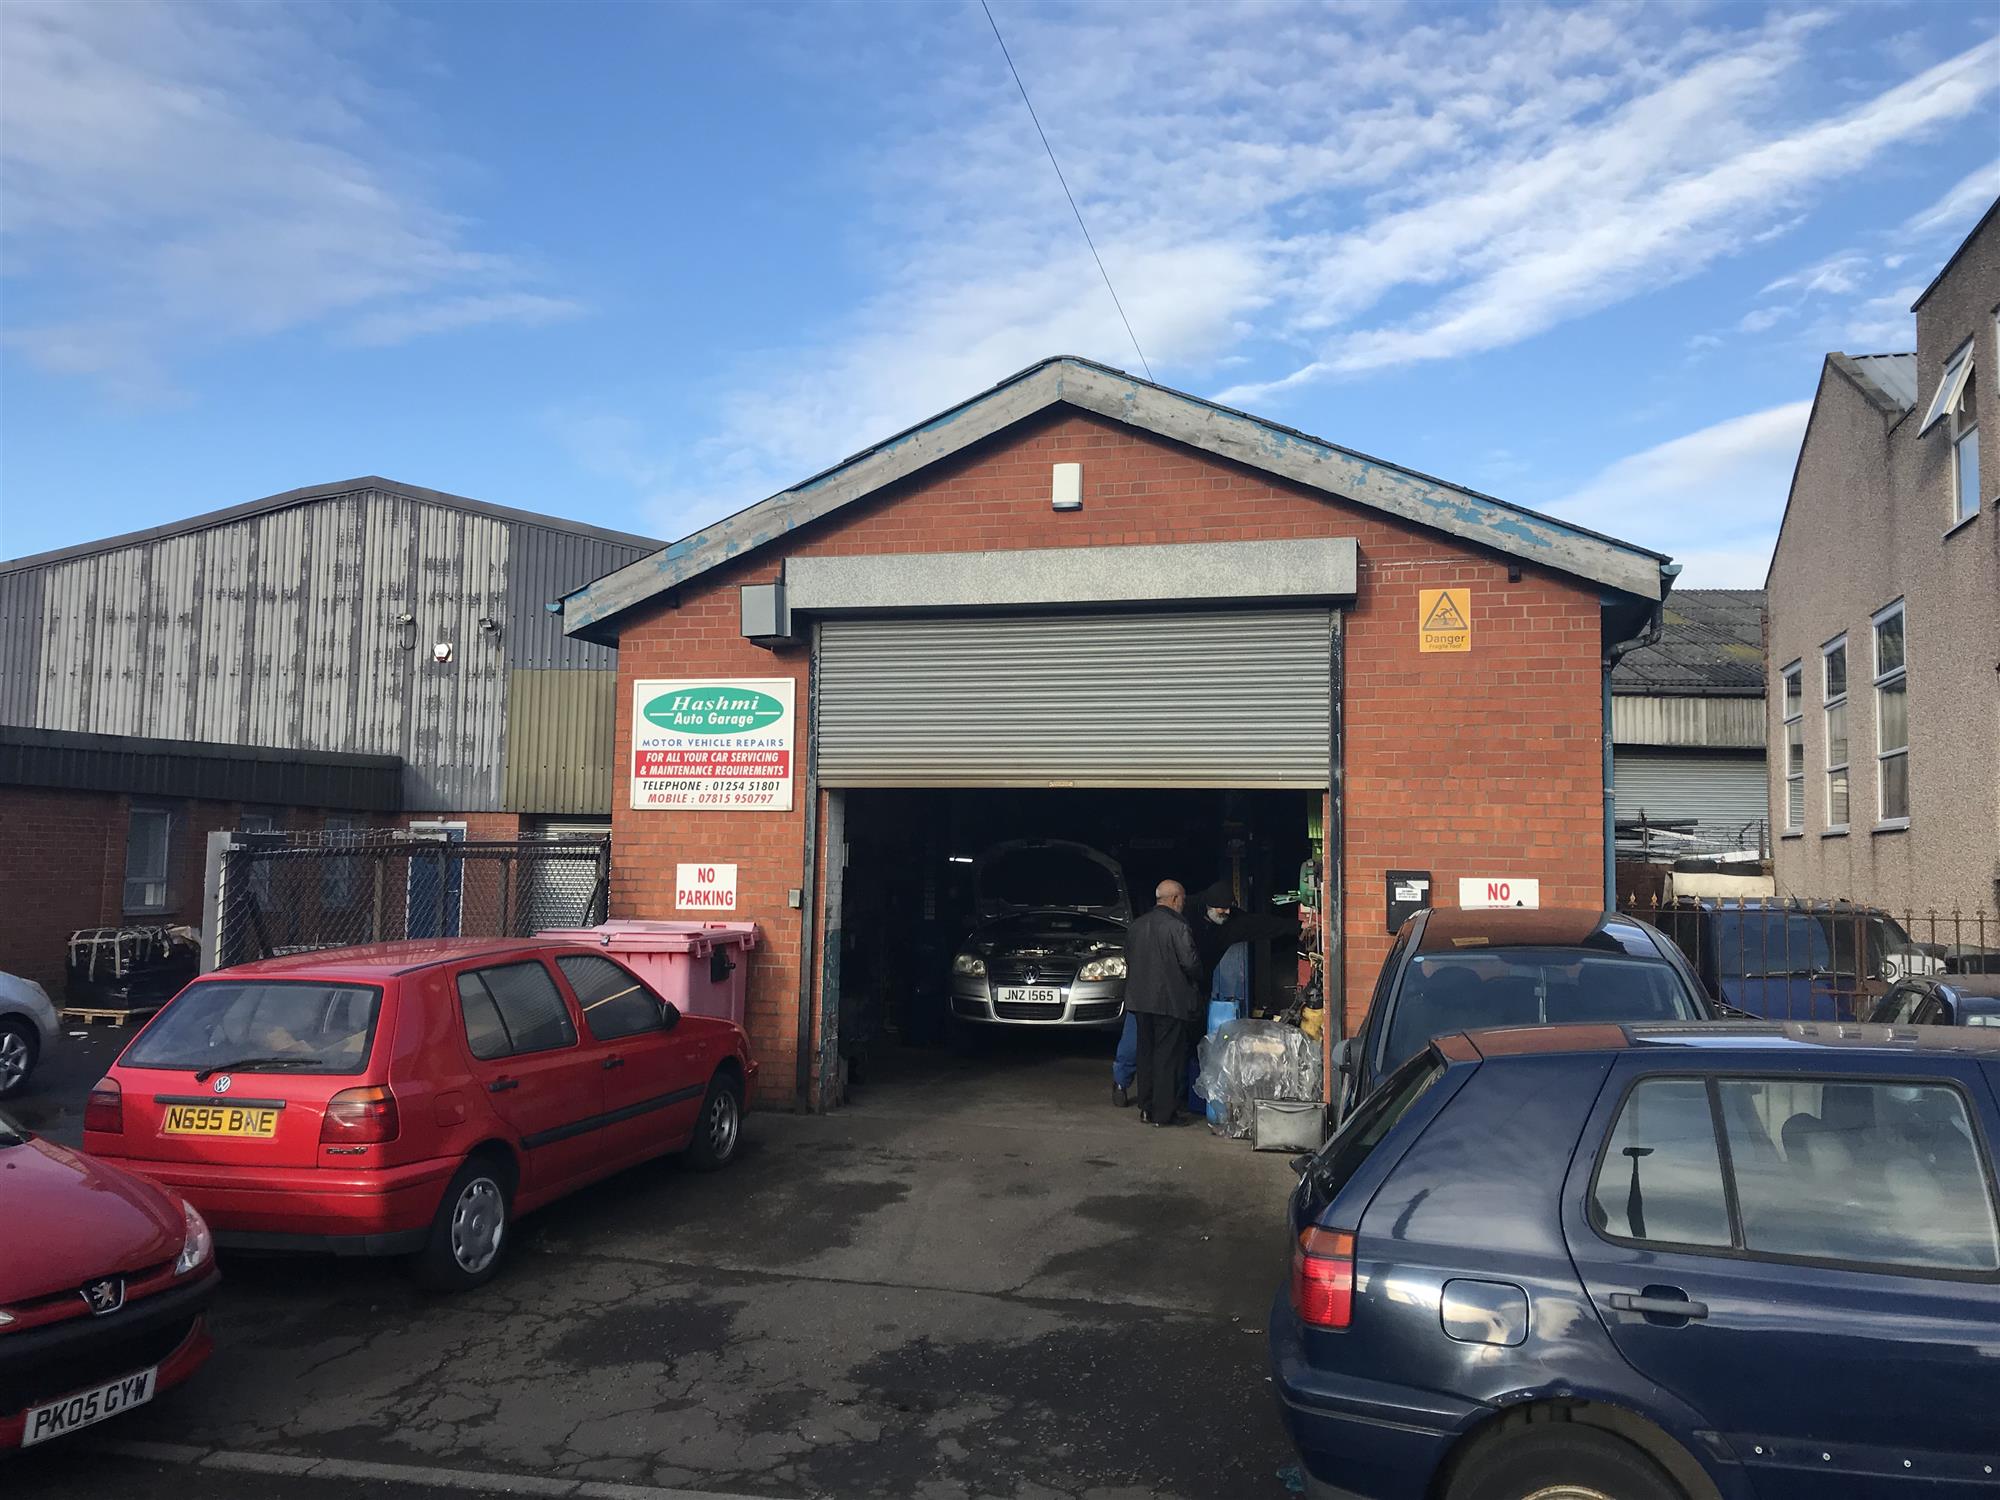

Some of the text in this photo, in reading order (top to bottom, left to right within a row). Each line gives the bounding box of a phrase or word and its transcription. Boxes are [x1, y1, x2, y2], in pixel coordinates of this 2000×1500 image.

[1425, 634, 1465, 645] Danger
[671, 695, 760, 711] Hashmi
[673, 712, 754, 727] Auto Garage
[642, 738, 784, 747] MOTOR VEHICLE REPAIRS
[646, 752, 779, 763] FOR ALL YOUR CAR SERVICING
[640, 765, 784, 776] & MAINTENANCE REQUIREMENTS
[642, 780, 702, 791] TELEPHONE
[712, 781, 744, 791] 01254
[748, 781, 780, 791] 51801
[647, 793, 688, 804] MOBILE
[698, 793, 731, 803] 07815
[735, 793, 774, 803] 950797
[697, 867, 715, 883] NO
[679, 890, 733, 906] PARKING
[1487, 883, 1510, 901] NO
[1005, 989, 1054, 1001] JNZ 1565
[168, 1107, 275, 1133] N695 BNE
[103, 1373, 149, 1413] GYW
